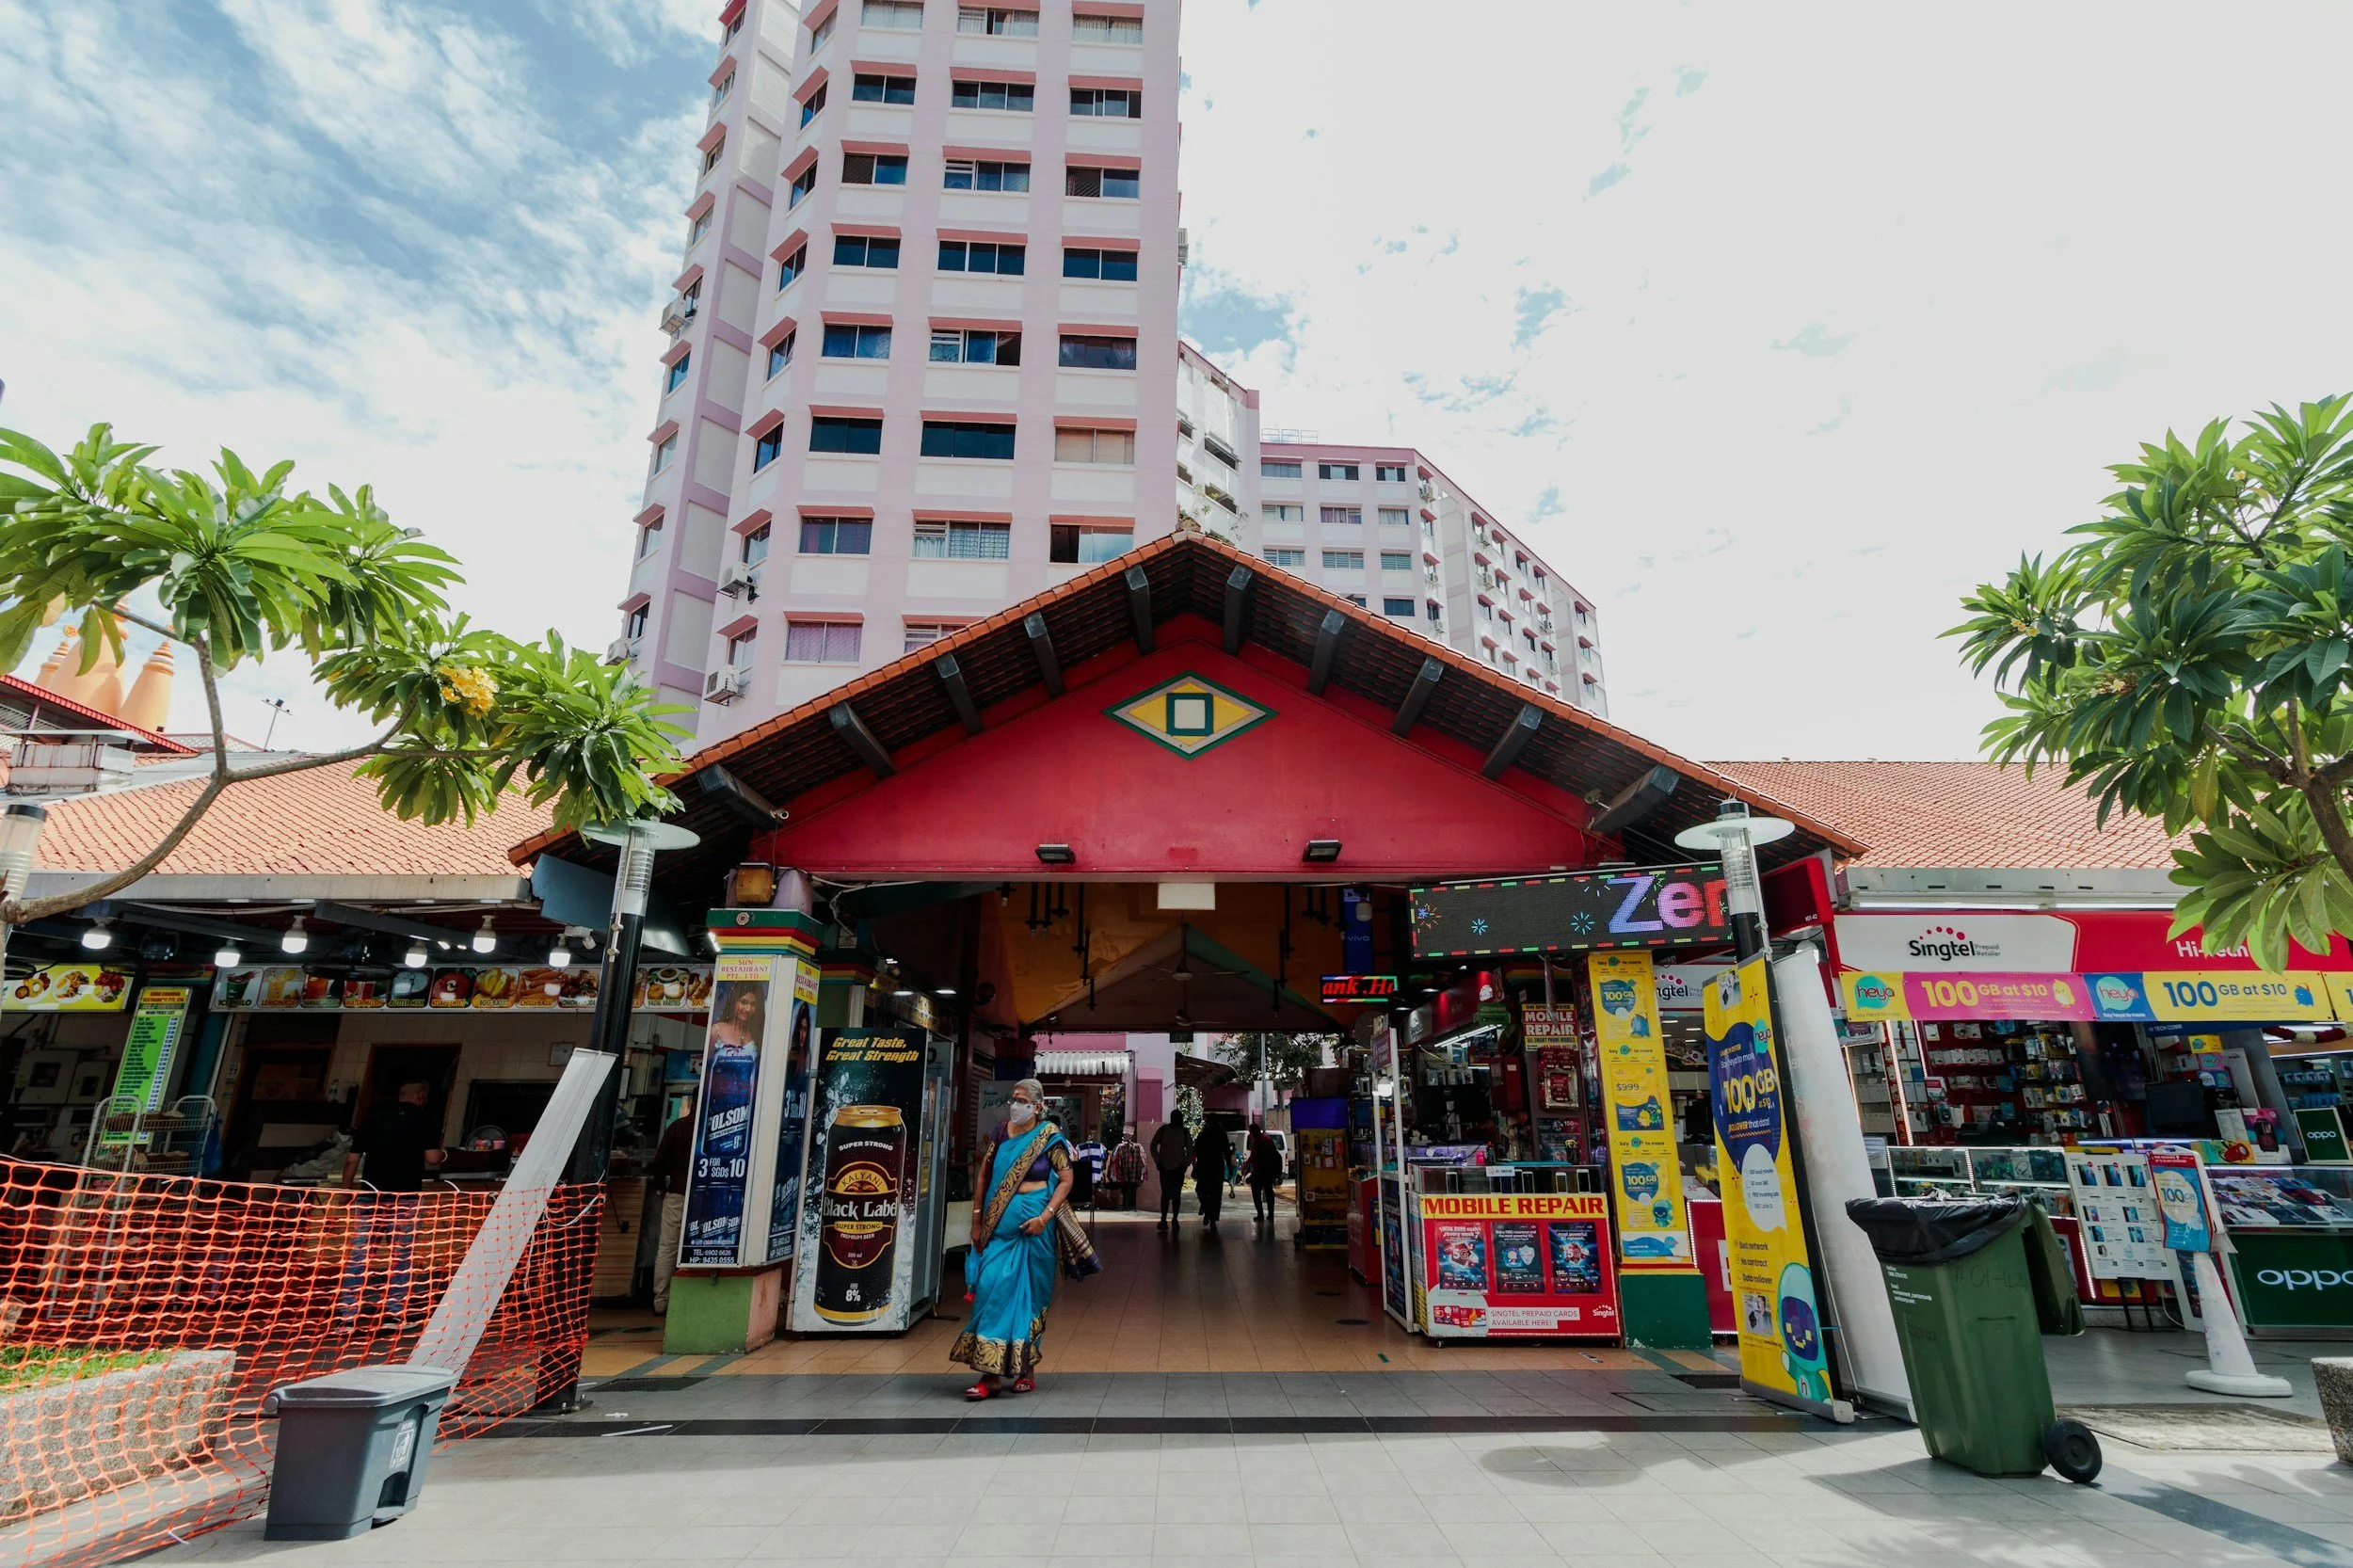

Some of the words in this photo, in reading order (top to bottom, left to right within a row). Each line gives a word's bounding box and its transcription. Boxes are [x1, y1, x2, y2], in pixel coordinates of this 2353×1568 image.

[1909, 940, 1976, 961] Singtel
[1604, 991, 1623, 1001] 100
[1657, 985, 1689, 1000] ngtel
[1856, 984, 1896, 1001] heya
[1921, 980, 1978, 1007] 100
[1978, 984, 2001, 996] GB
[2003, 985, 2021, 996] at
[2022, 984, 2048, 997] $10
[2100, 985, 2138, 1000] heya
[2163, 982, 2218, 1008] 100
[2218, 984, 2239, 996] GB
[2243, 985, 2259, 996] at
[1526, 1024, 1575, 1035] REPAIR
[832, 1037, 869, 1048] Great
[870, 1037, 906, 1049] Taste,
[826, 1050, 861, 1062] Great
[864, 1049, 920, 1064] Strength
[1616, 1082, 1639, 1092] $999
[1723, 1074, 1756, 1113] 100
[1755, 1068, 1776, 1095] GB
[2307, 1131, 2336, 1140] oppo
[839, 1142, 863, 1151] SUPER
[864, 1141, 894, 1151] STRONG
[698, 1159, 708, 1177] 3
[710, 1158, 720, 1167] FOR
[729, 1158, 745, 1177] 10
[841, 1172, 883, 1188] KALYANI
[1625, 1176, 1646, 1186] 100
[2161, 1188, 2185, 1202] 100
[823, 1196, 859, 1221] Black
[1425, 1198, 1512, 1214] MOBILE
[1518, 1197, 1604, 1214] REPAIR
[1750, 1242, 1769, 1251] network
[1748, 1257, 1768, 1267] contract
[1753, 1275, 1772, 1284] rollover
[845, 1288, 861, 1302] 8%
[1593, 1309, 1615, 1319] Singtel
